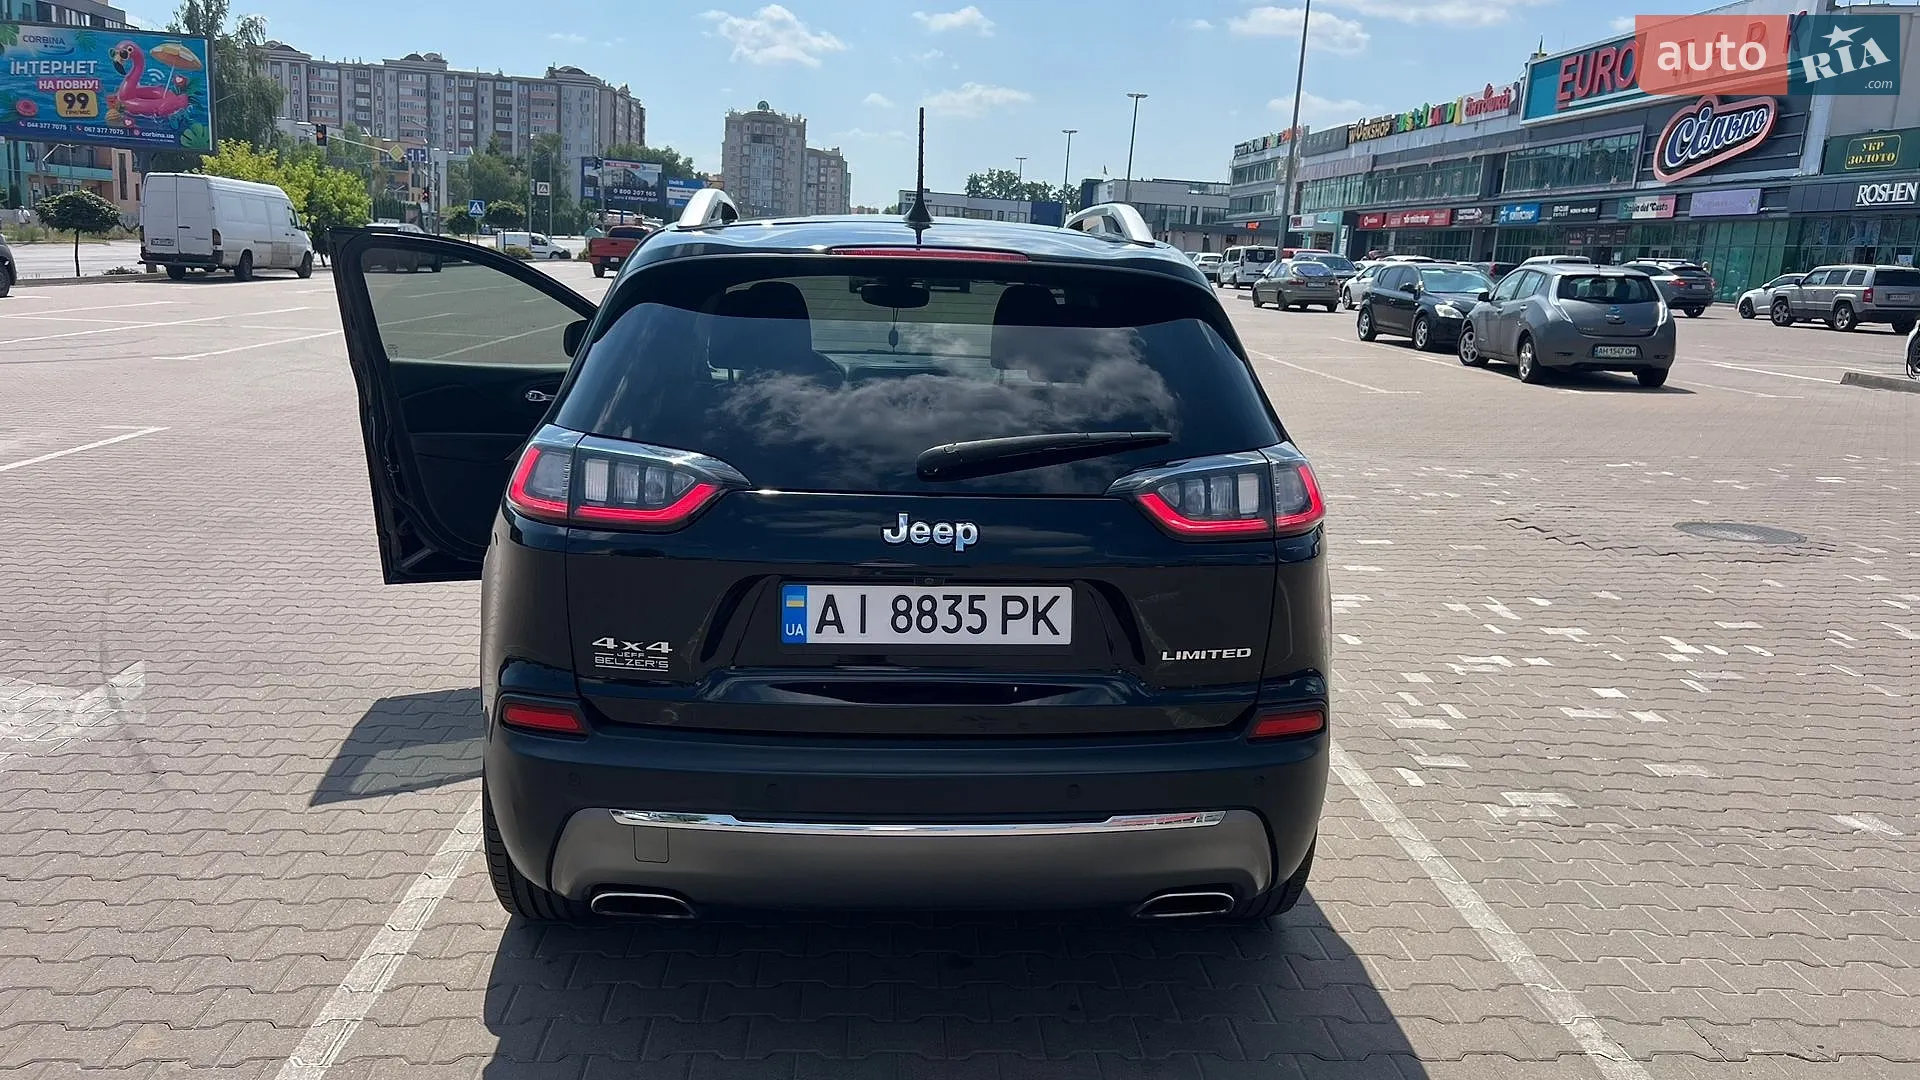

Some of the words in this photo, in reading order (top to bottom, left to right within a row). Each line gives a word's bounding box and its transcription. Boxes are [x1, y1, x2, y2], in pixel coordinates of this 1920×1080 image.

[22, 34, 66, 46] CORBINA
[1556, 40, 1641, 102] EURO
[39, 80, 55, 89] НА
[56, 80, 99, 89] ПОВНУ!
[63, 92, 90, 110] 99
[50, 123, 67, 131] 7075
[1348, 117, 1391, 144] WORKSHOP
[141, 131, 175, 140] corbina.ua
[1664, 106, 1768, 168] Сільпо
[1862, 141, 1884, 152] УКР
[1847, 152, 1896, 165] ЗОЛОТО
[1856, 182, 1918, 206] ROSHEN
[883, 513, 978, 551] Jeep
[815, 594, 867, 634] AI
[891, 594, 987, 634] 8835
[1001, 596, 1060, 635] PK
[785, 623, 804, 636] UA
[1161, 648, 1252, 661] LIMITED
[594, 657, 669, 668] BELZER'S
